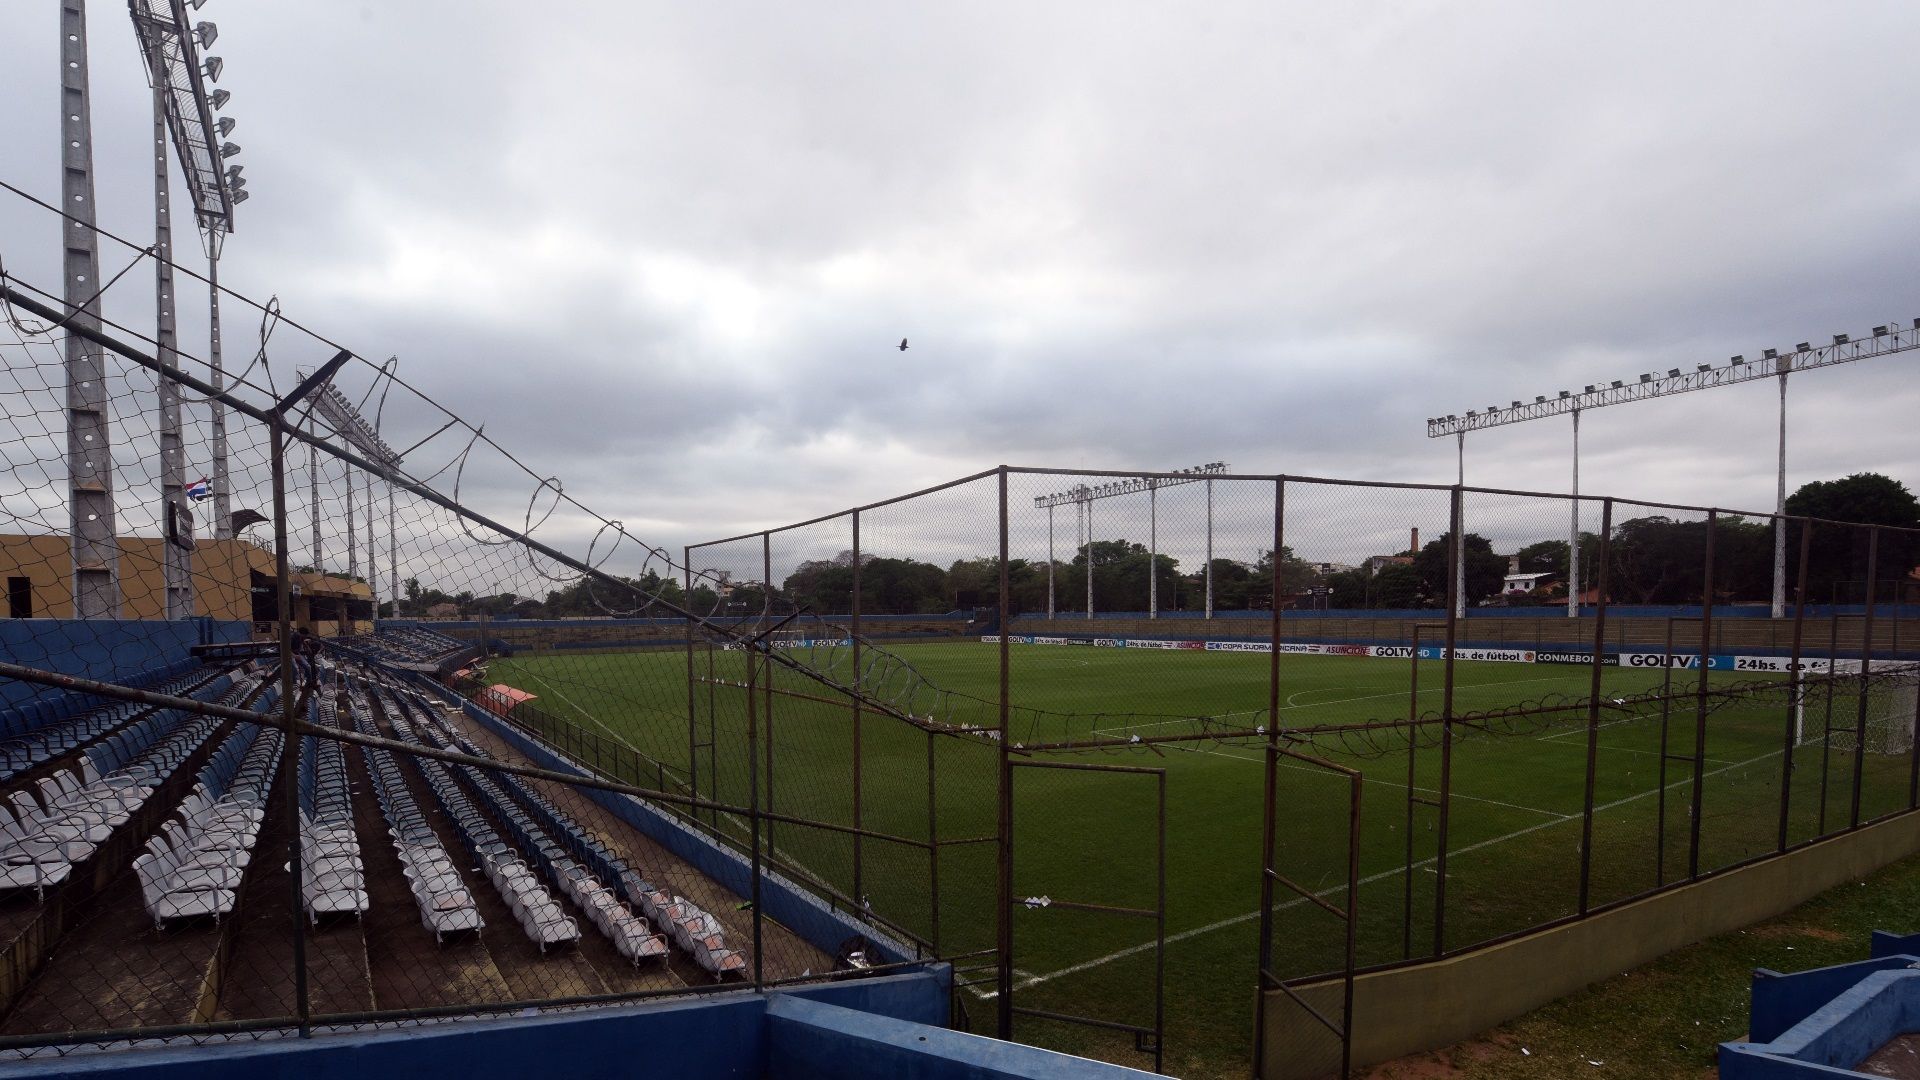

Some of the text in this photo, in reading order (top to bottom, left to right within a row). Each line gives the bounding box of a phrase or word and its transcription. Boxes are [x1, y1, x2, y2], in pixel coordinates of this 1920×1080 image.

[1243, 643, 1308, 652] SUDAMRICANA
[1442, 649, 1520, 661] 2hs. de fútbol
[1737, 659, 1780, 671] 24hs.
